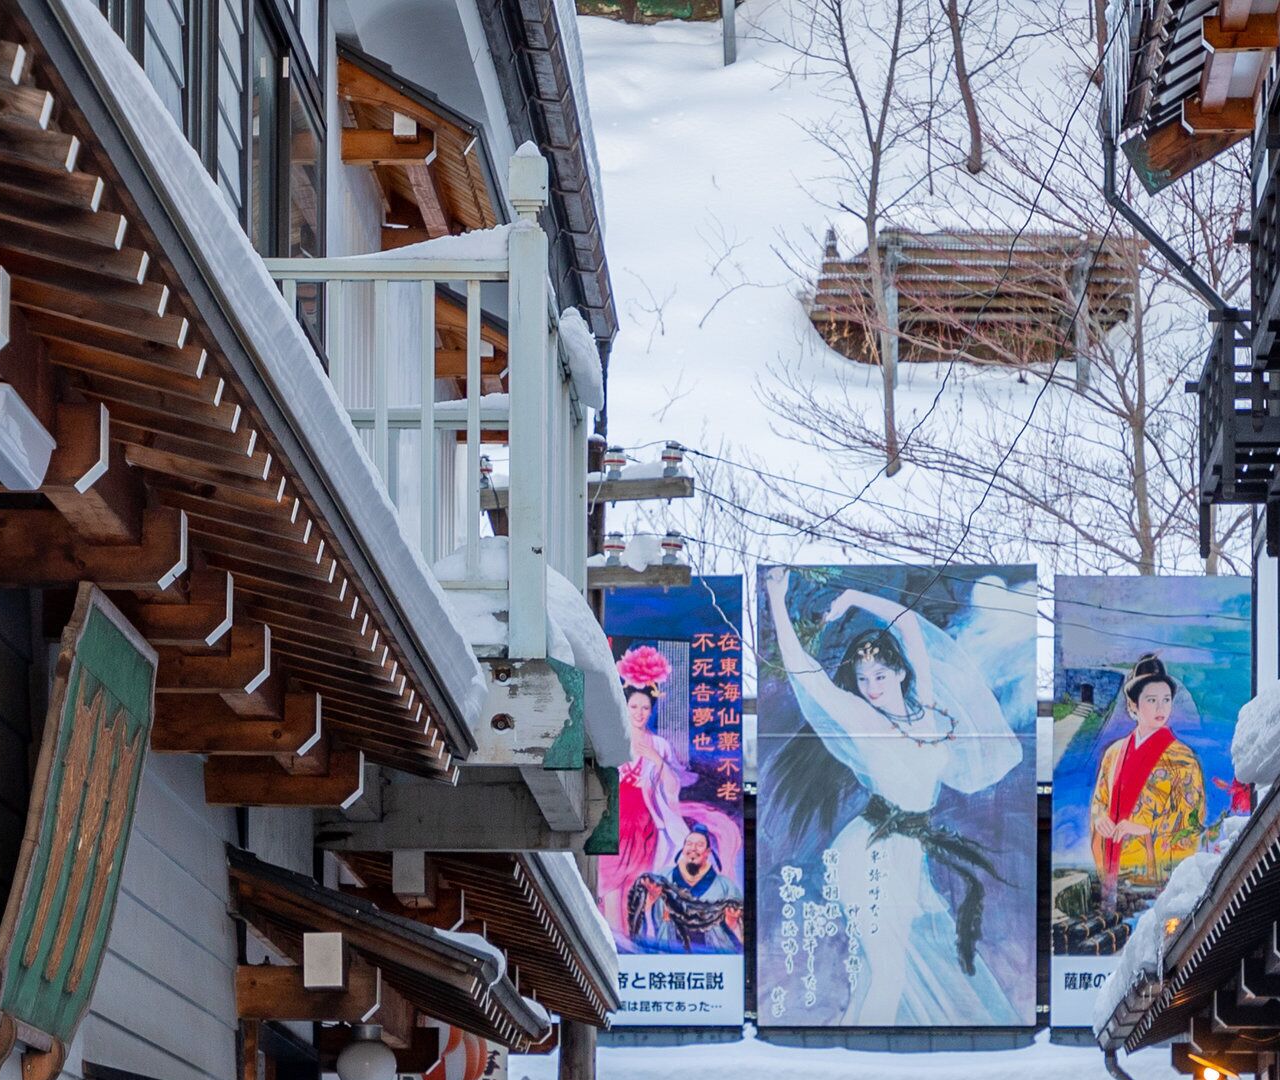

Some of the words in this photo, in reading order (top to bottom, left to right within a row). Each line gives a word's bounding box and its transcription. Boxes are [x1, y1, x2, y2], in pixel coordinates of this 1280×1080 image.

[692, 633, 715, 751] 不死告夢也
[1065, 973, 1110, 990] 薩摩の
